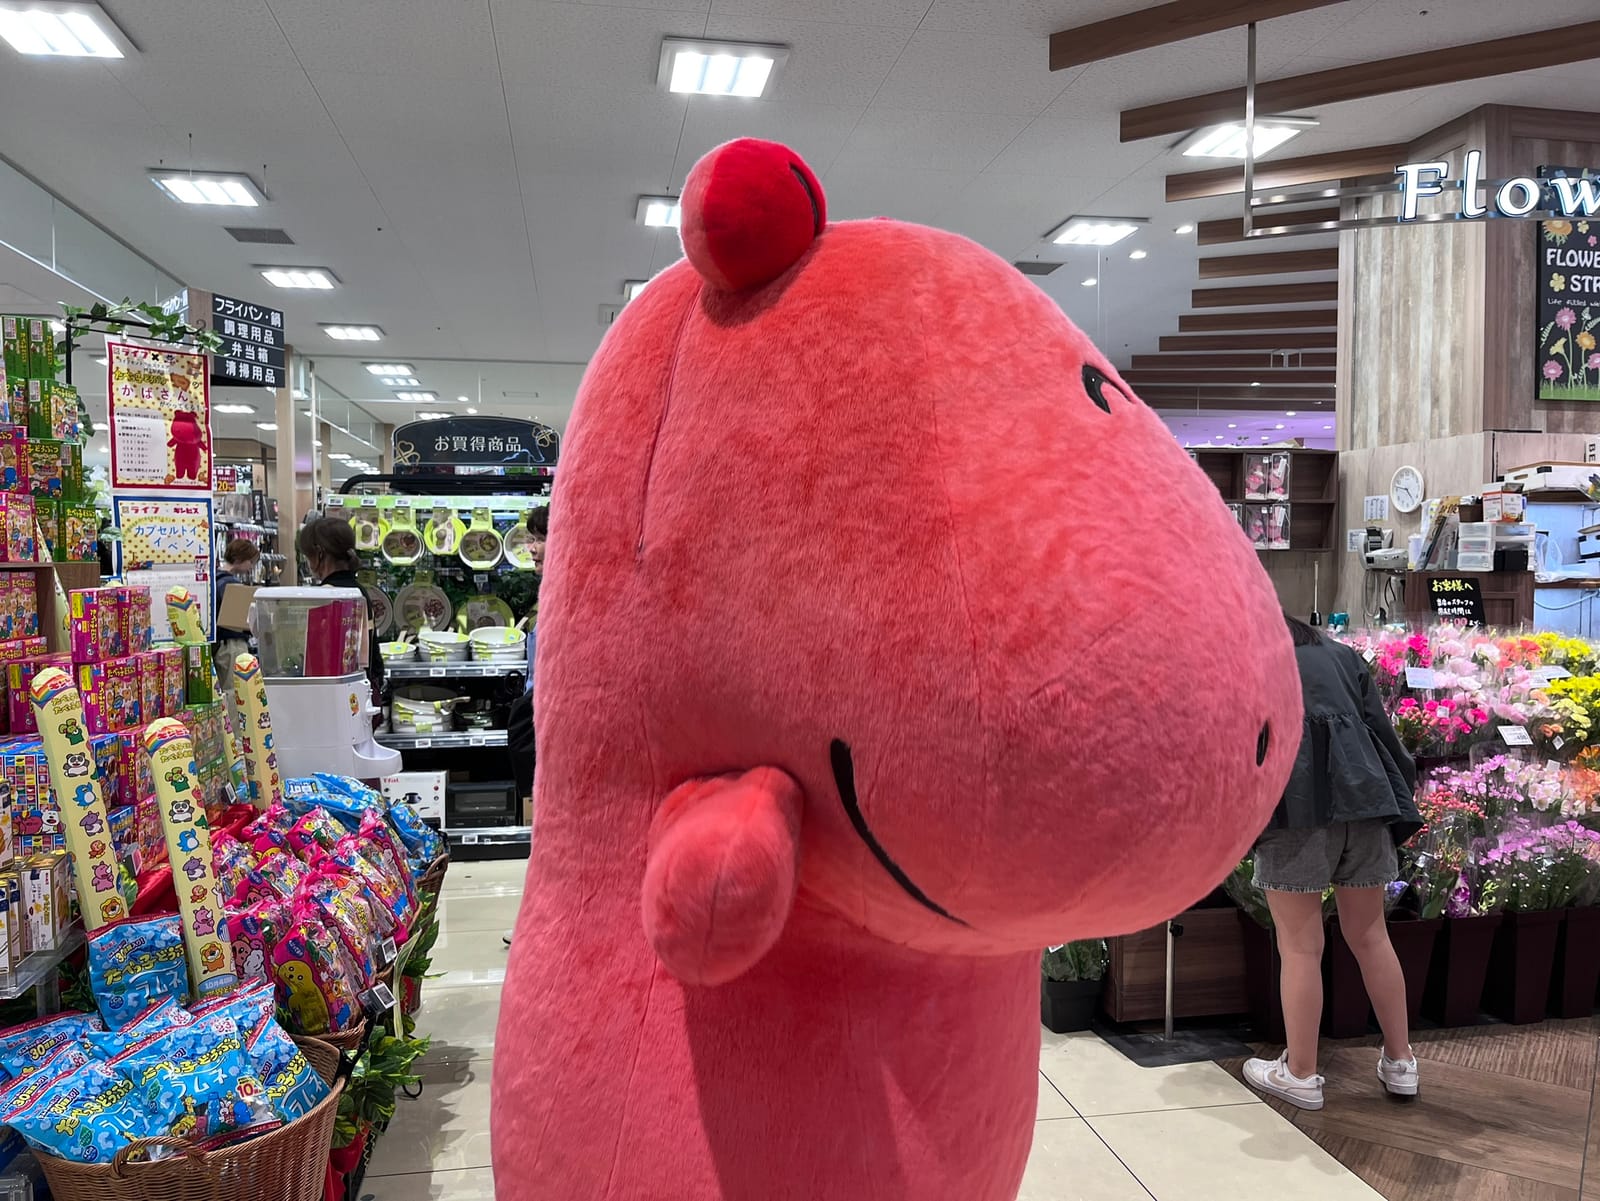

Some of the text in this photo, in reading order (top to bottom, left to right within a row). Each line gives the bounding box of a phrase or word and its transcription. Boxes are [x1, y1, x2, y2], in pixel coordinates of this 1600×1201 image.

[215, 297, 282, 328] フライパン・鍋
[224, 319, 275, 345] 調理用品
[122, 348, 148, 359] ライフ
[231, 341, 269, 363] 弁当箱
[226, 359, 276, 384] 清掃用品
[121, 384, 188, 402] かばさん
[434, 436, 522, 452] お買得商品
[130, 506, 160, 514] ライフ
[135, 525, 198, 537] カプセルトイ
[154, 537, 204, 554] イベント
[1431, 579, 1474, 592] お客様へ
[135, 970, 184, 999] ラムネ
[170, 1068, 228, 1099] ラムネ
